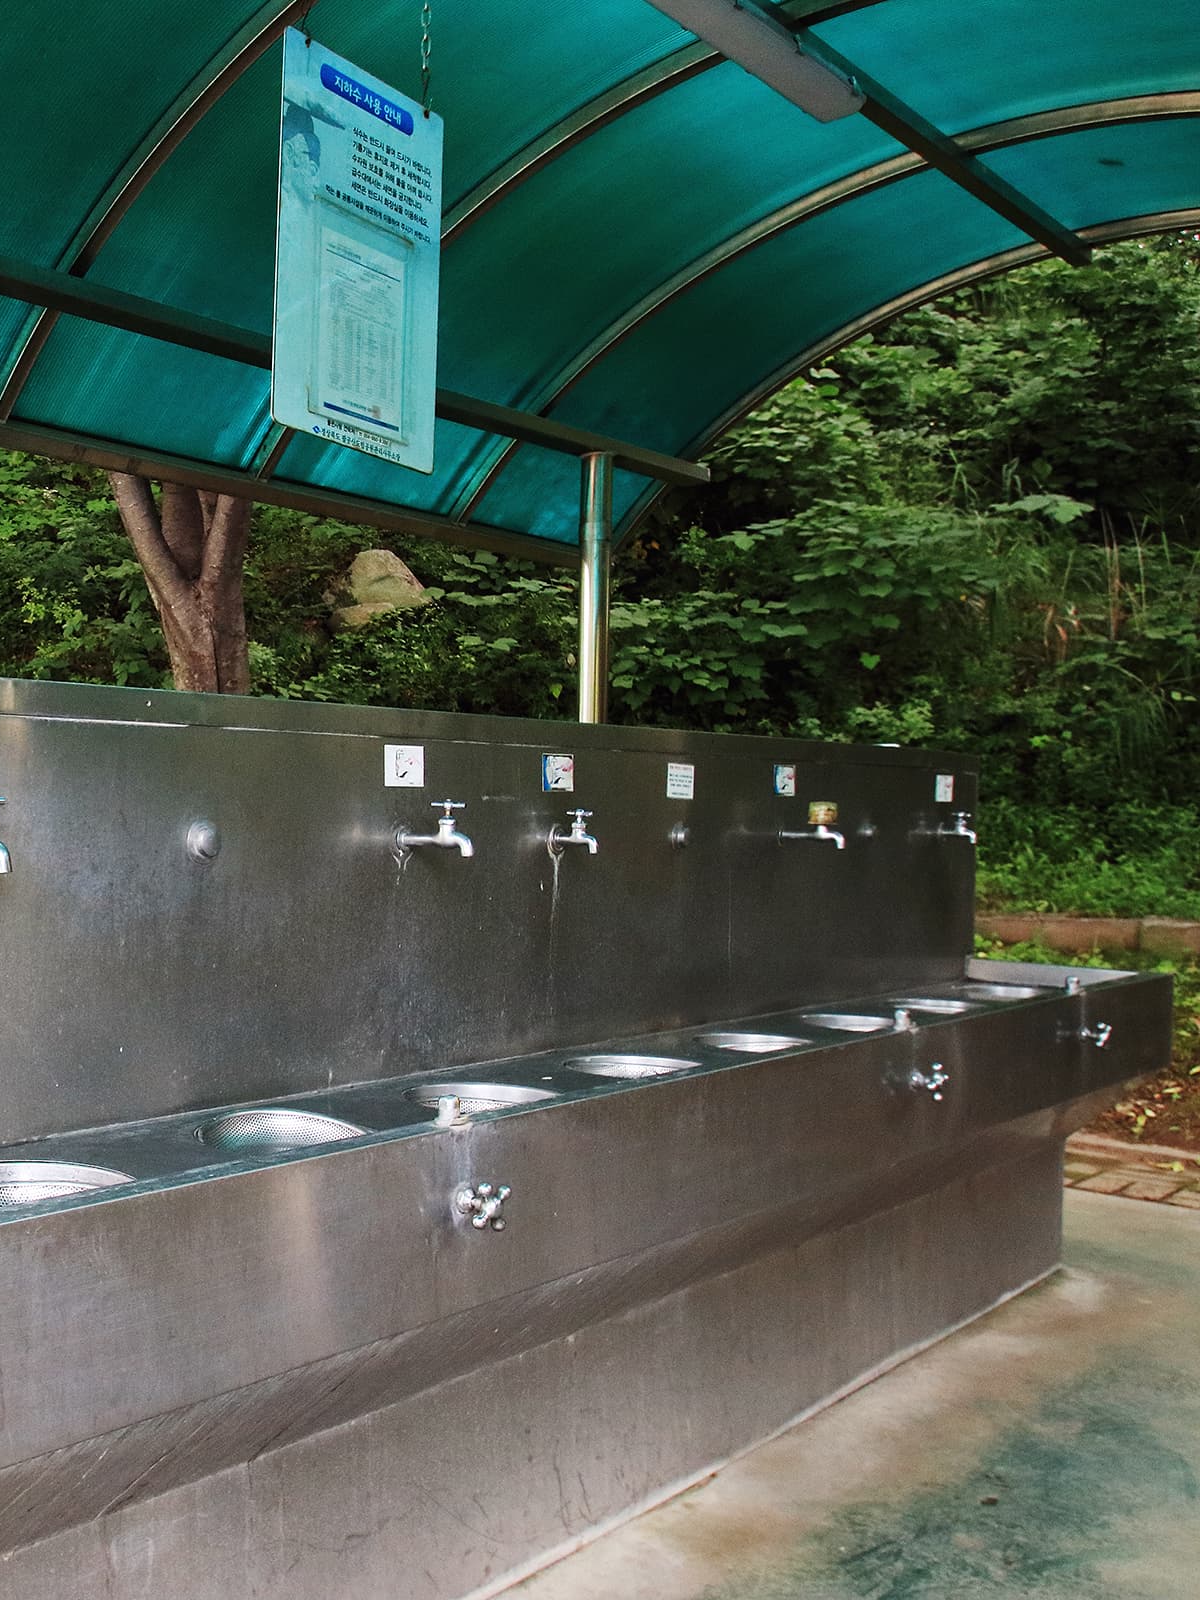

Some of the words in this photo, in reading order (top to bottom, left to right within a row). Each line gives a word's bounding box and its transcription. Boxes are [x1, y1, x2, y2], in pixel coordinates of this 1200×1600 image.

[334, 75, 362, 103] 지하수
[364, 93, 382, 115] 사용
[384, 105, 402, 126] 안내
[353, 127, 368, 142] 식수는
[369, 137, 385, 151] 반드시
[397, 152, 411, 166] 드시기
[412, 160, 432, 178] 바랍니다.
[353, 141, 373, 158] 기름기는
[374, 152, 388, 166] 휴지로
[390, 161, 399, 172] 제거
[401, 167, 406, 175] 후
[352, 154, 367, 169] 수자원
[369, 162, 383, 177] 보호를
[385, 171, 395, 183] 위해
[396, 177, 405, 189] 물을
[351, 181, 367, 196] 세면은
[368, 189, 383, 204] 반드시
[384, 198, 403, 215] 화장실을
[352, 167, 381, 189] 급수대에서는
[382, 184, 397, 198] 세면을
[398, 191, 423, 212] 금지합니다.
[401, 222, 414, 234] 주시기
